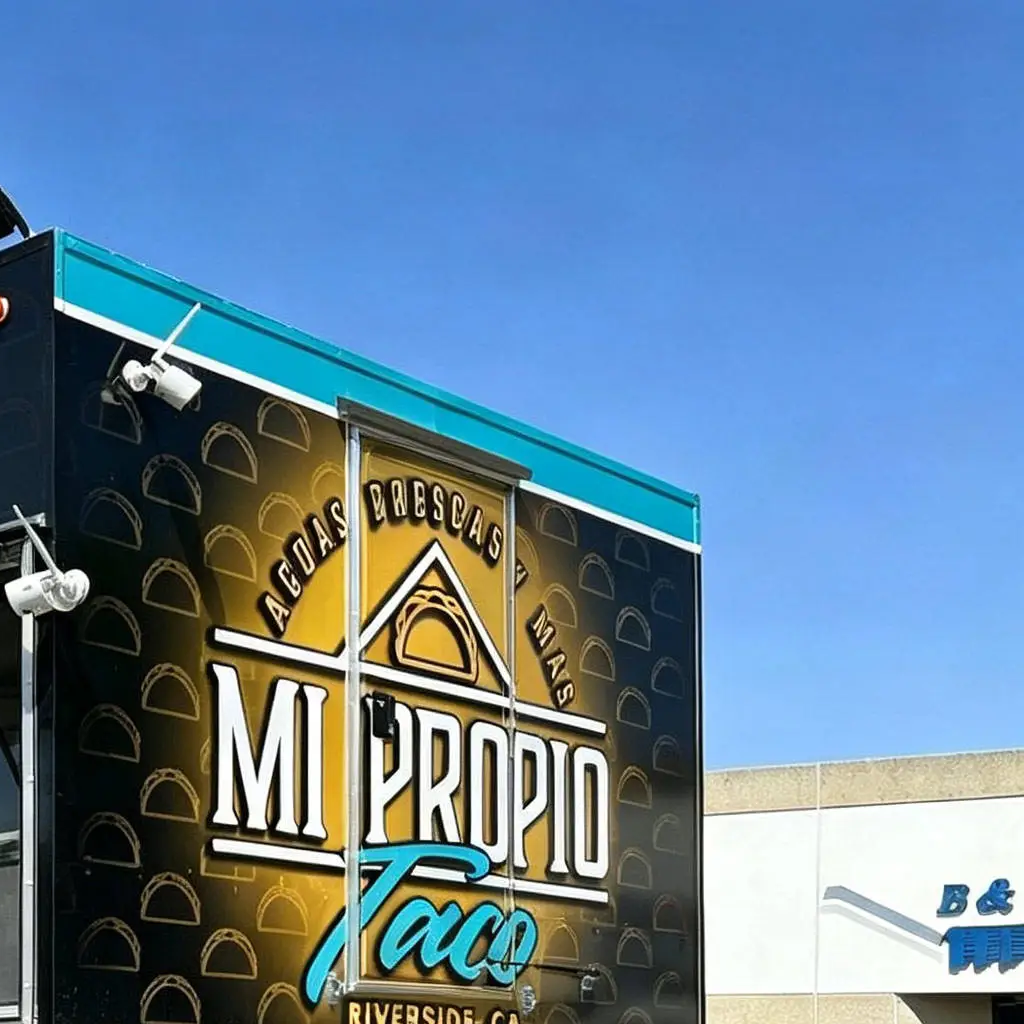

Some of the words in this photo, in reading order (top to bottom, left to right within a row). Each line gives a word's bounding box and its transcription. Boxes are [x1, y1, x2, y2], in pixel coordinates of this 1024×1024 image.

[212, 663, 329, 838] MI
[364, 697, 608, 879] PROPIO
[306, 843, 538, 1003] Taco
[936, 884, 970, 918] B
